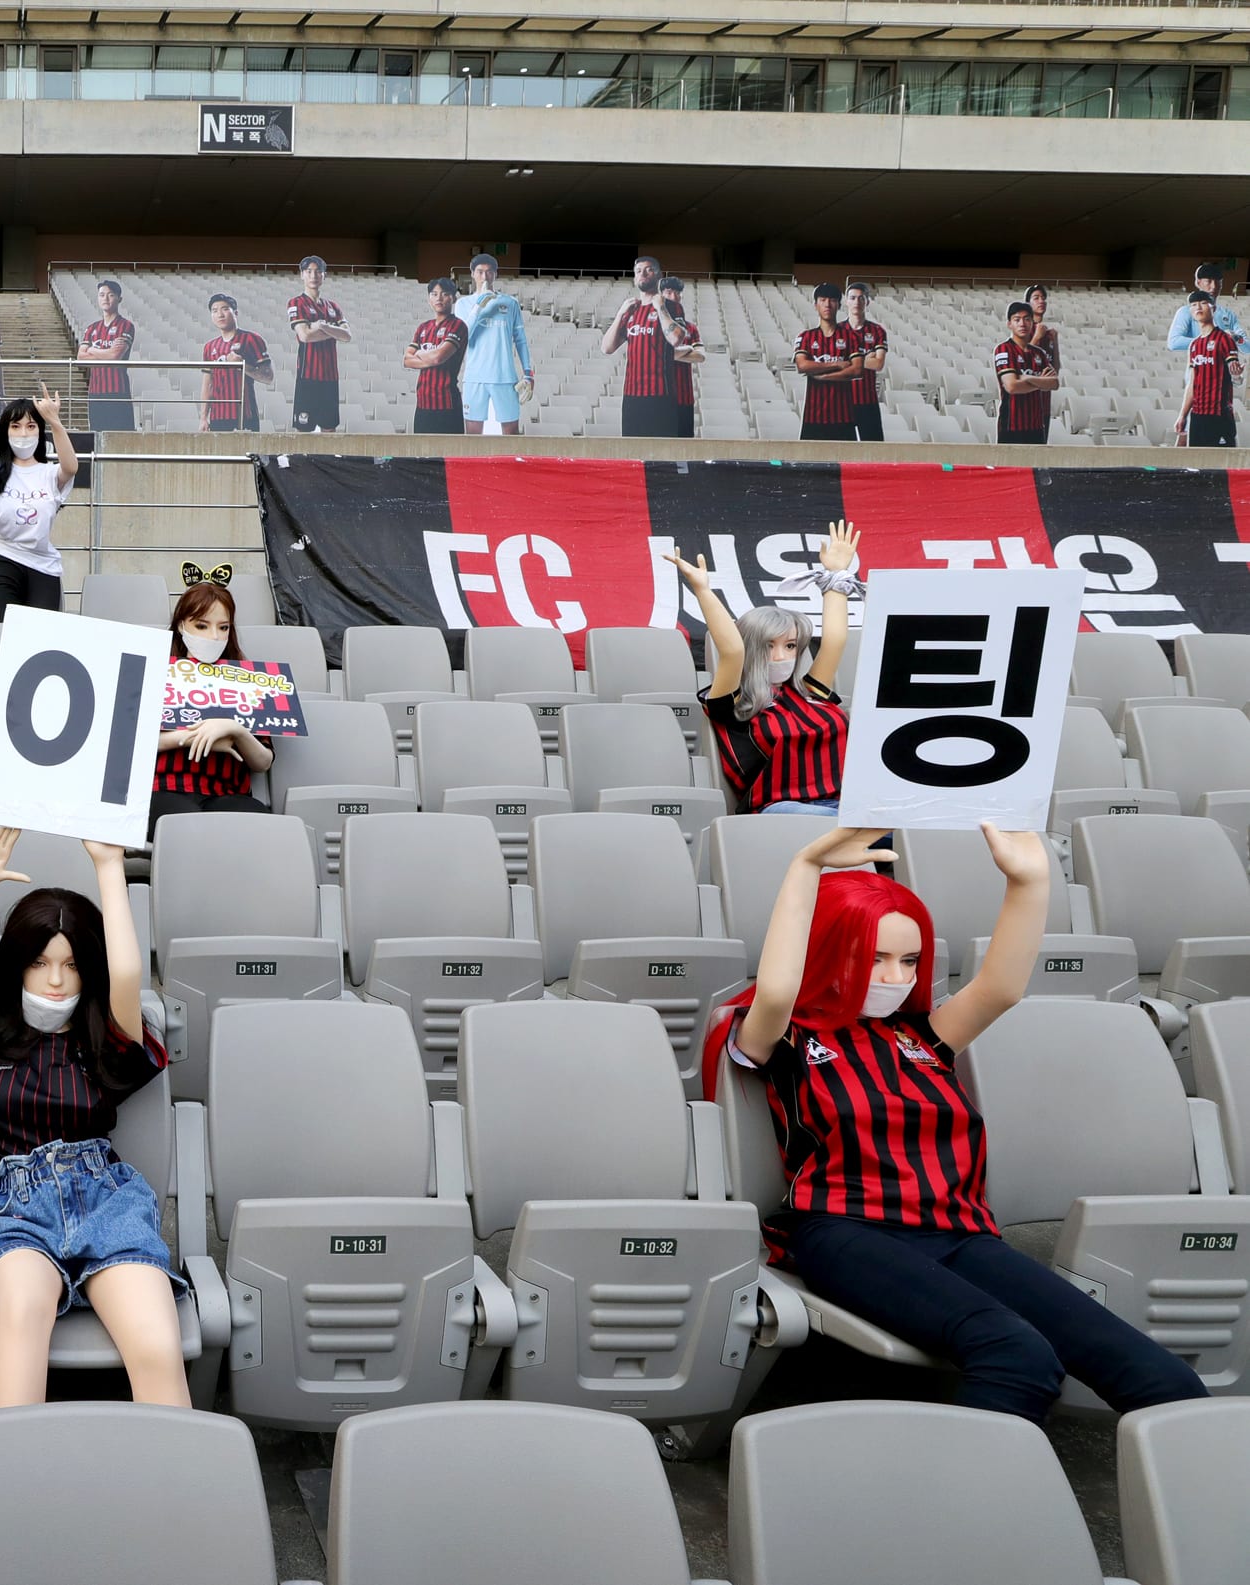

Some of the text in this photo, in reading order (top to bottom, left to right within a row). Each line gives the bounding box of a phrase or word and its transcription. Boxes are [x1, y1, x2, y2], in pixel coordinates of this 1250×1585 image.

[203, 113, 265, 143] N SECTOR
[422, 530, 587, 634] FC
[5, 649, 147, 806] 이
[198, 663, 293, 692] 아드리아노
[876, 606, 1050, 788] 팅
